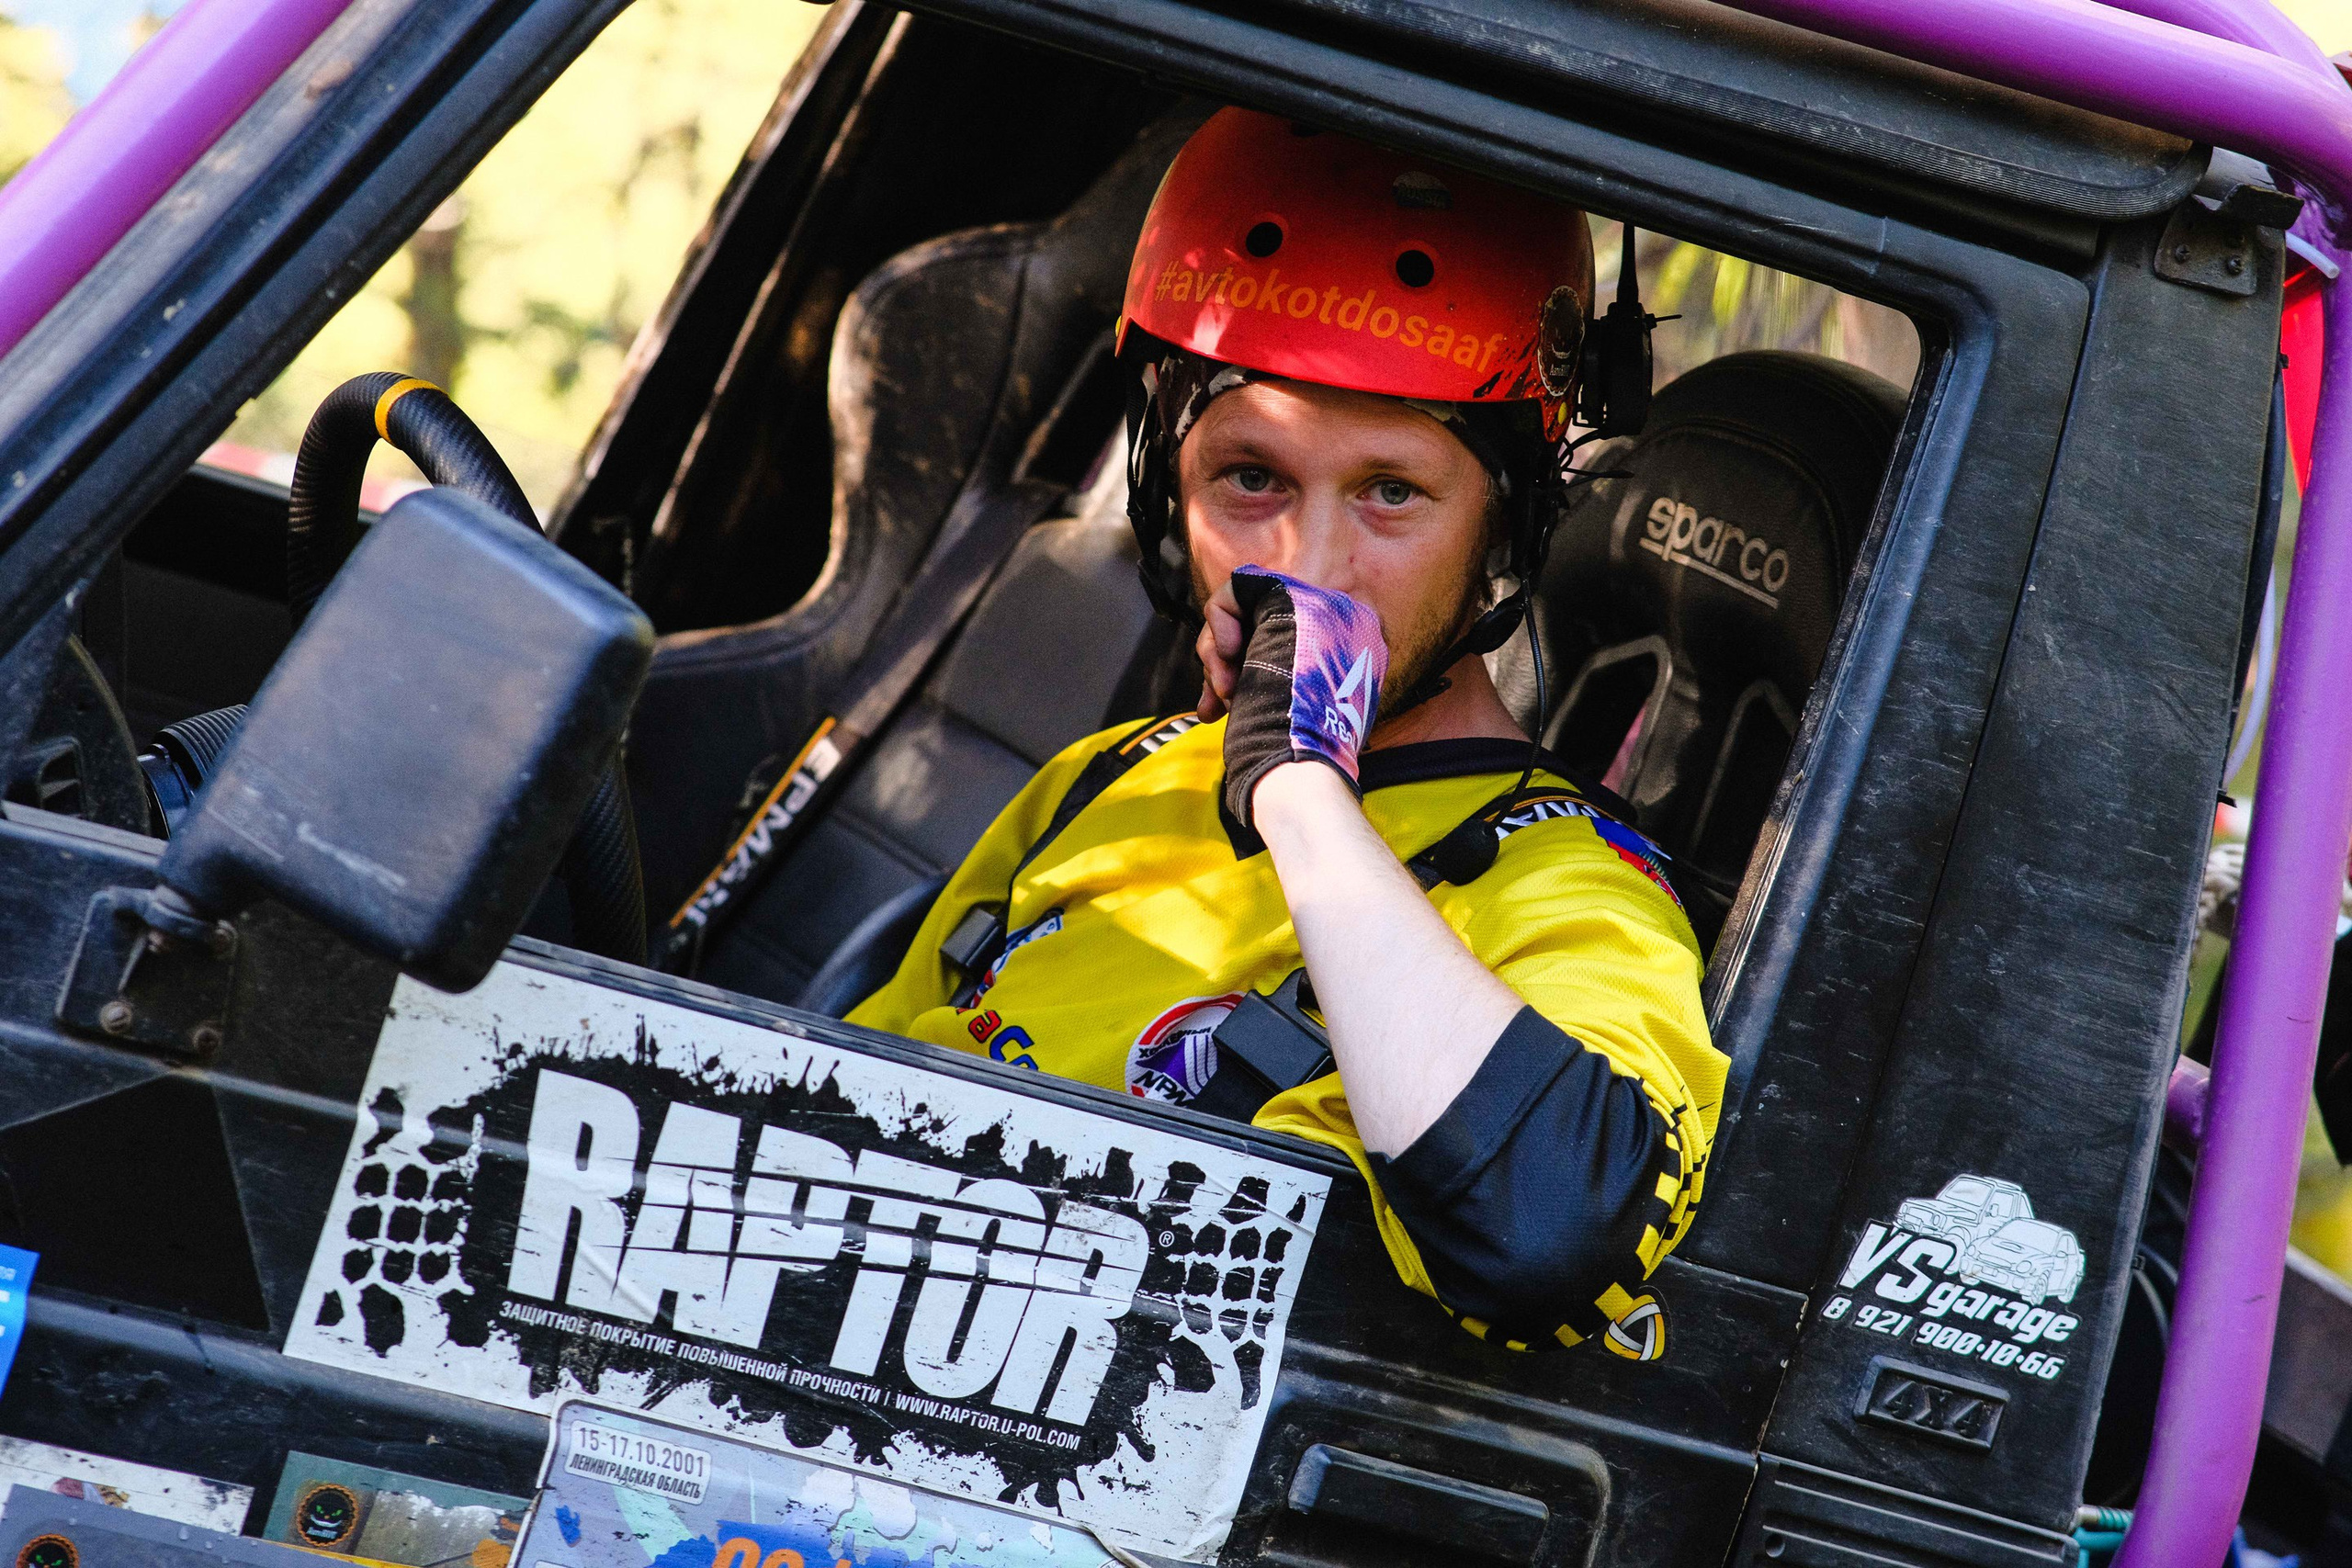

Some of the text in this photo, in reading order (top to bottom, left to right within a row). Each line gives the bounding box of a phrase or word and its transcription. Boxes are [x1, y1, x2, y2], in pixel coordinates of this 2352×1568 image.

[1155, 261, 1504, 374] #avtokotdosaaf
[1646, 497, 1789, 592] sparco
[509, 1068, 1149, 1427] RAPTOR
[1839, 1223, 2079, 1343] VS garage
[1823, 1296, 1852, 1319] 8
[1854, 1304, 1914, 1337] 921
[500, 1301, 588, 1335] ЗАЩИТНОЕ
[590, 1321, 676, 1357] ПОКРЫТИЕ
[676, 1342, 787, 1382] ПОВЫШЕННОЙ
[789, 1369, 881, 1404] ПРОЧНОСТИ
[896, 1393, 1081, 1450] WWW.RAPTOR.U-POL.COM
[569, 1453, 701, 1499] ЛЕНИНГРАДСКАЯ ОБЛАСТЬ
[579, 1427, 705, 1477] 15-17.10.2001
